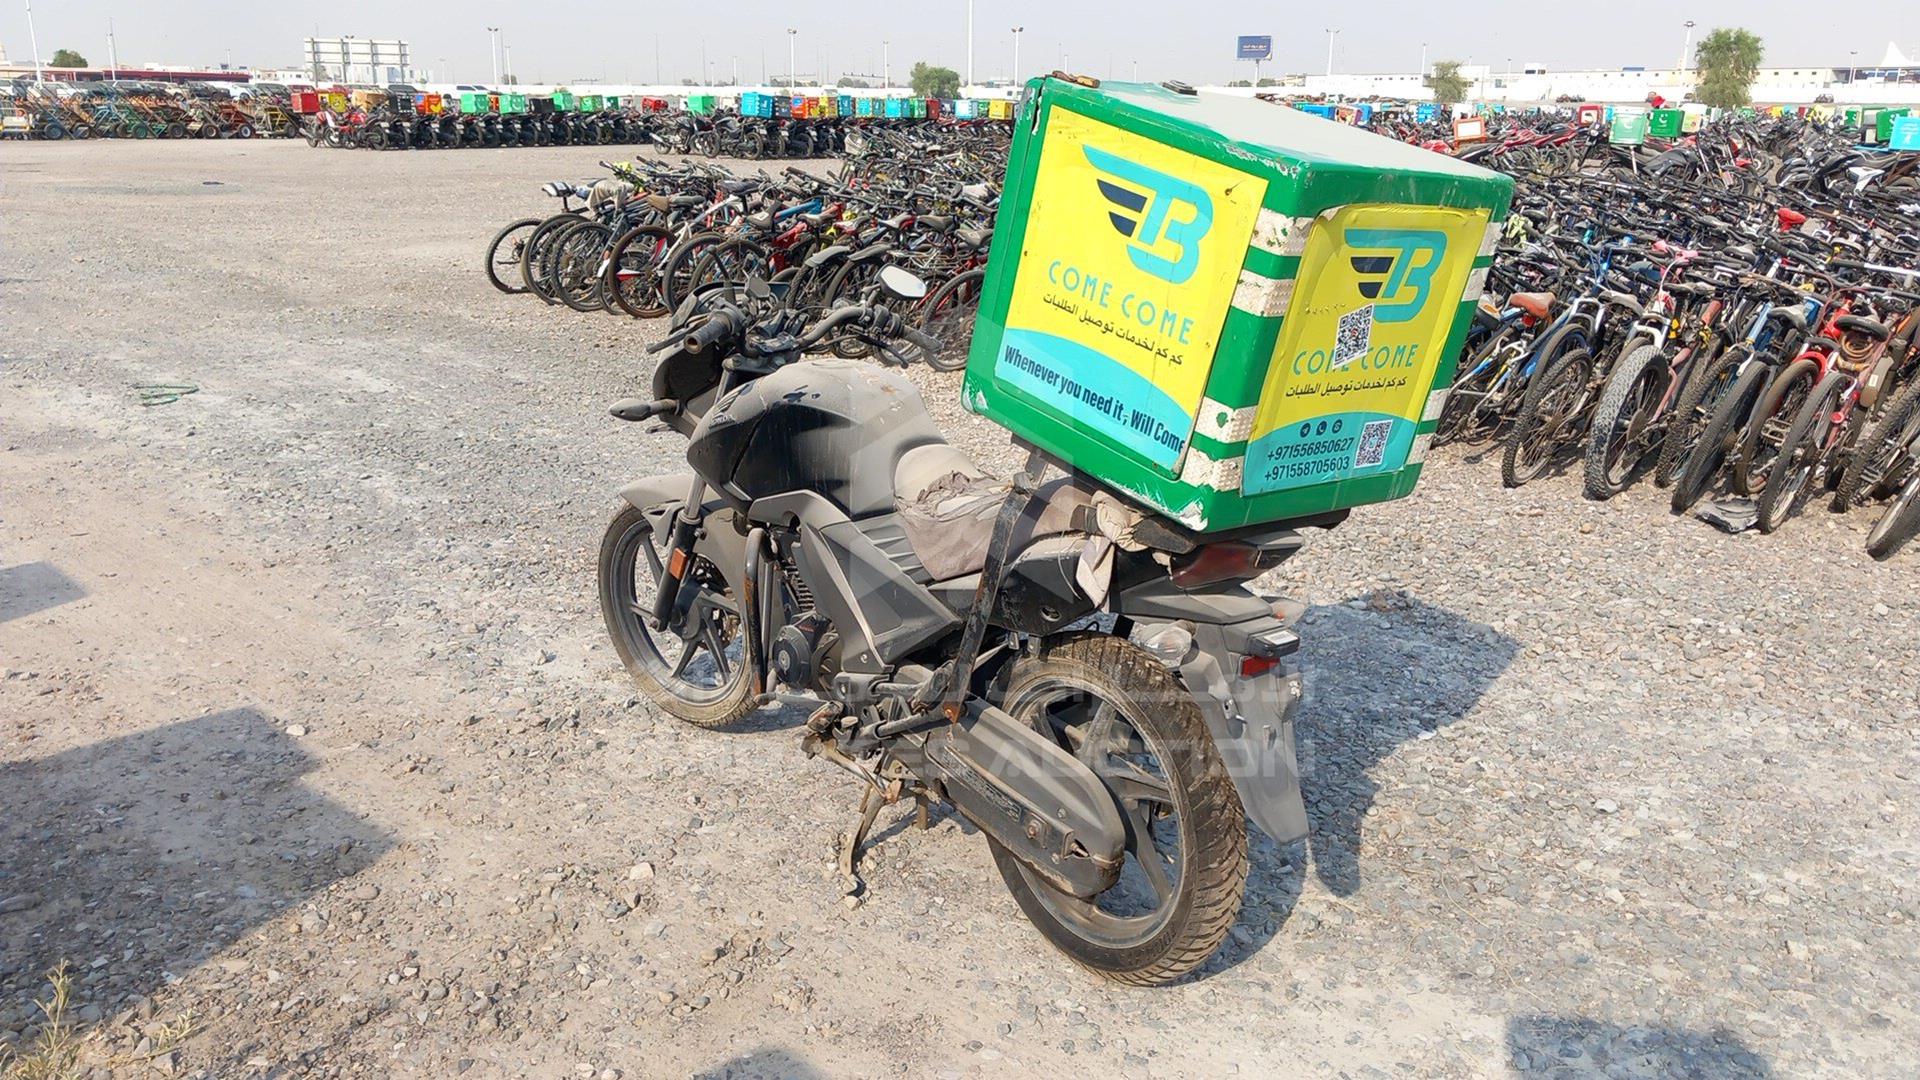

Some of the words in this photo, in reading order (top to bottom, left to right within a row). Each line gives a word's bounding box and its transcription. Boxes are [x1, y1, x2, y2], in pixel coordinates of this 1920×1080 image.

[1043, 293, 1080, 316] الطلبات
[1048, 260, 1113, 308] COME
[1121, 293, 1194, 345] COME
[1078, 310, 1115, 335] توصيل
[1361, 343, 1419, 370] COME
[1004, 345, 1060, 387] Whenever
[1058, 375, 1082, 399] you
[1082, 388, 1113, 415] need
[1130, 409, 1155, 437] Will
[1267, 437, 1355, 461] +971556850627
[1264, 456, 1350, 481] +971558705603
